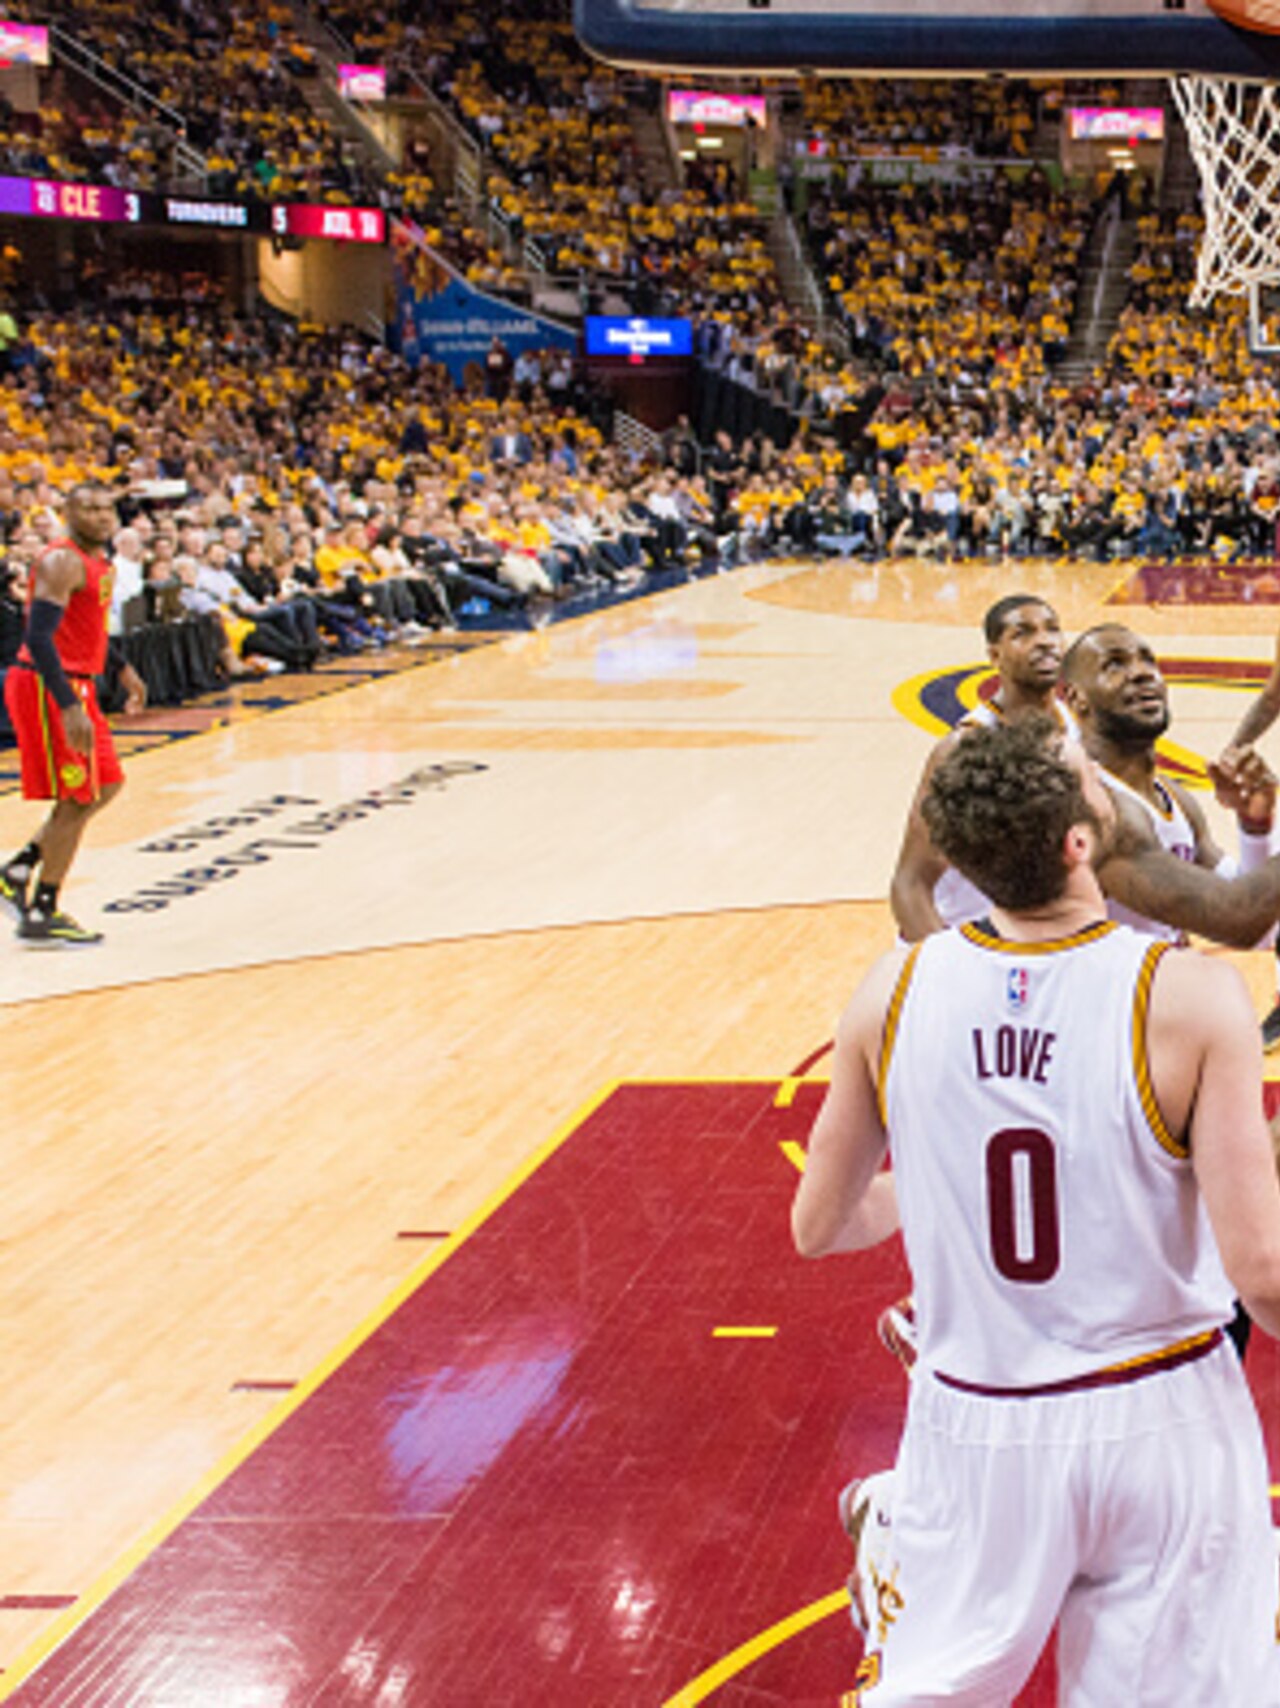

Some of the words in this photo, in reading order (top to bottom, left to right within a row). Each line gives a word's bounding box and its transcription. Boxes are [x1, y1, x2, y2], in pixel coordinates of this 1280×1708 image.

[60, 185, 101, 217] CLE
[125, 193, 140, 222] 3
[272, 206, 287, 234] 5
[323, 211, 354, 239] ATL
[138, 794, 320, 853] Arena
[971, 1023, 1057, 1087] LOVE
[985, 1127, 1061, 1285] 0
